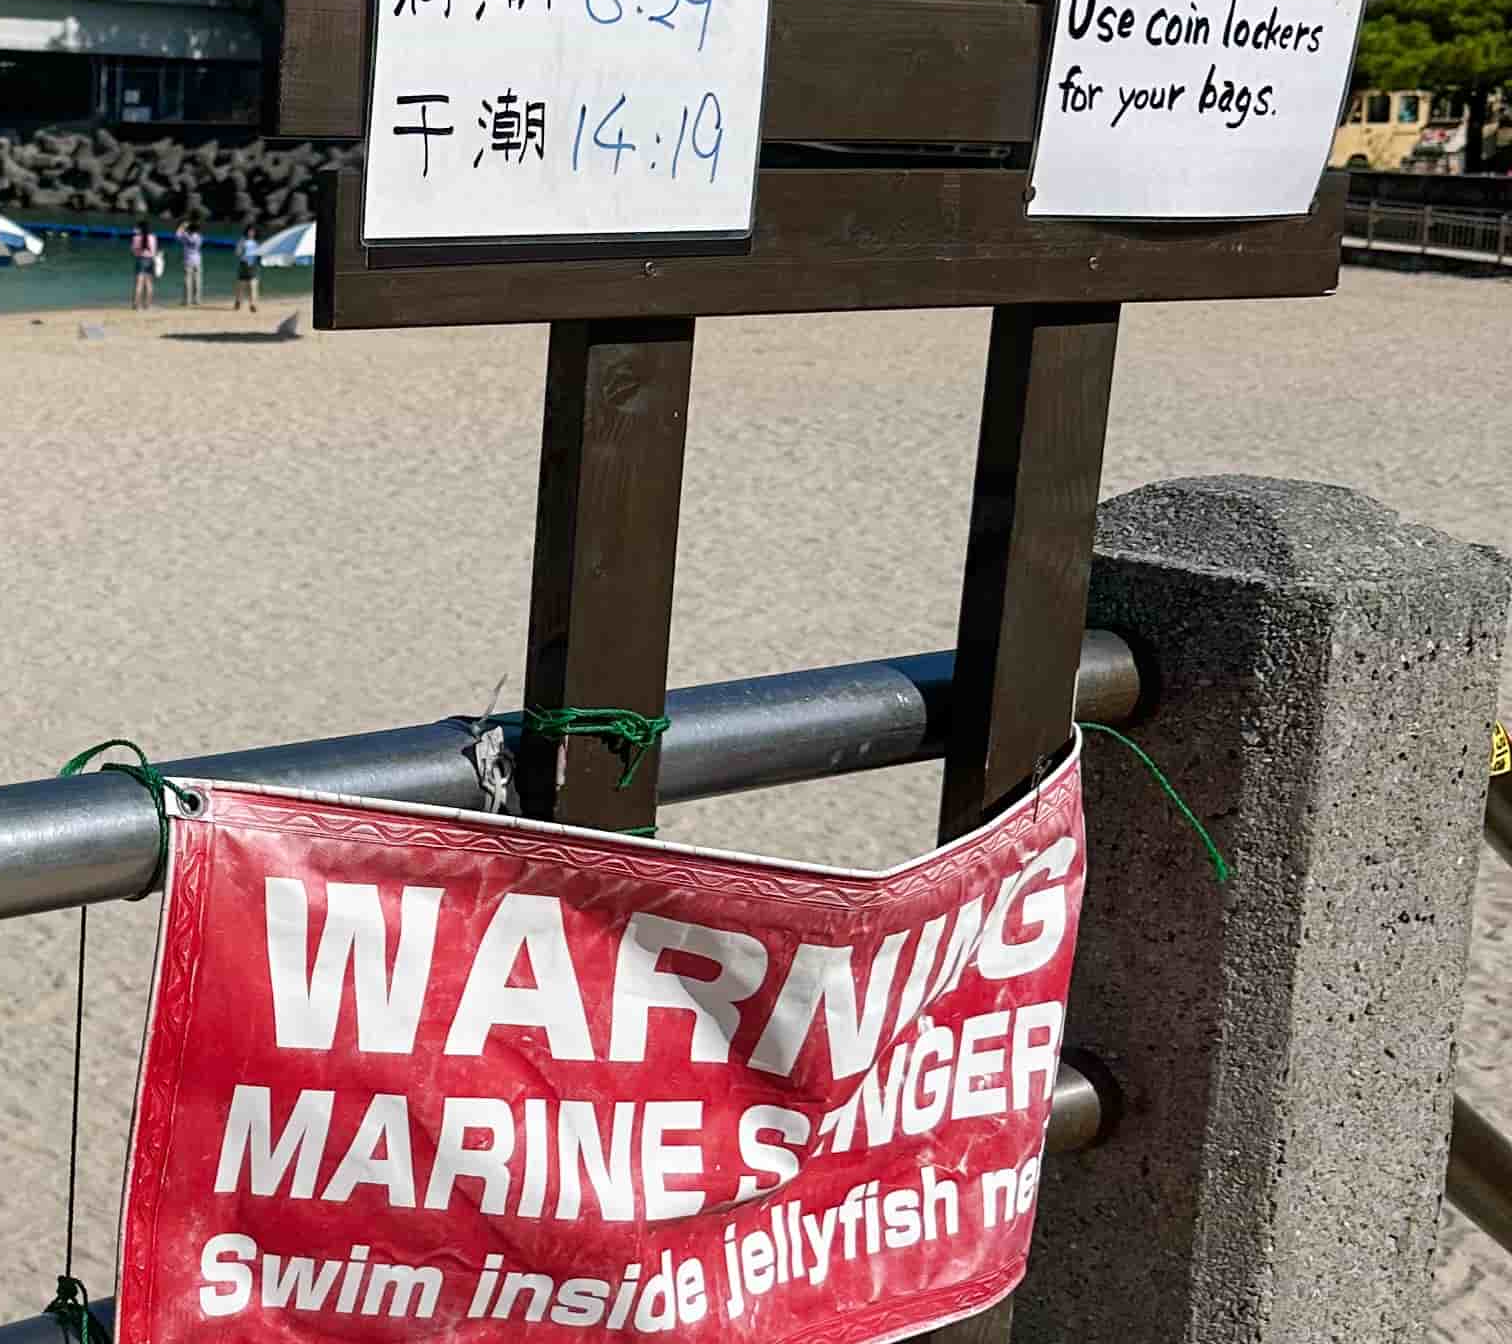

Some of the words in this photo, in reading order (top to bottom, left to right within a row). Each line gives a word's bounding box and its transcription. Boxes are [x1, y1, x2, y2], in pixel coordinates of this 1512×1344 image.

[1145, 2, 1210, 46] coin
[393, 88, 545, 178] 干潮
[573, 92, 723, 183] 14:19
[1059, 66, 1103, 112] for
[1112, 83, 1185, 127] your
[1199, 64, 1277, 129] bags.
[263, 836, 1077, 1081] WARNING
[213, 1085, 704, 1223] MARINE
[198, 1233, 442, 1319] Swim
[474, 1249, 708, 1334] inside
[723, 1167, 958, 1321] jellyfish
